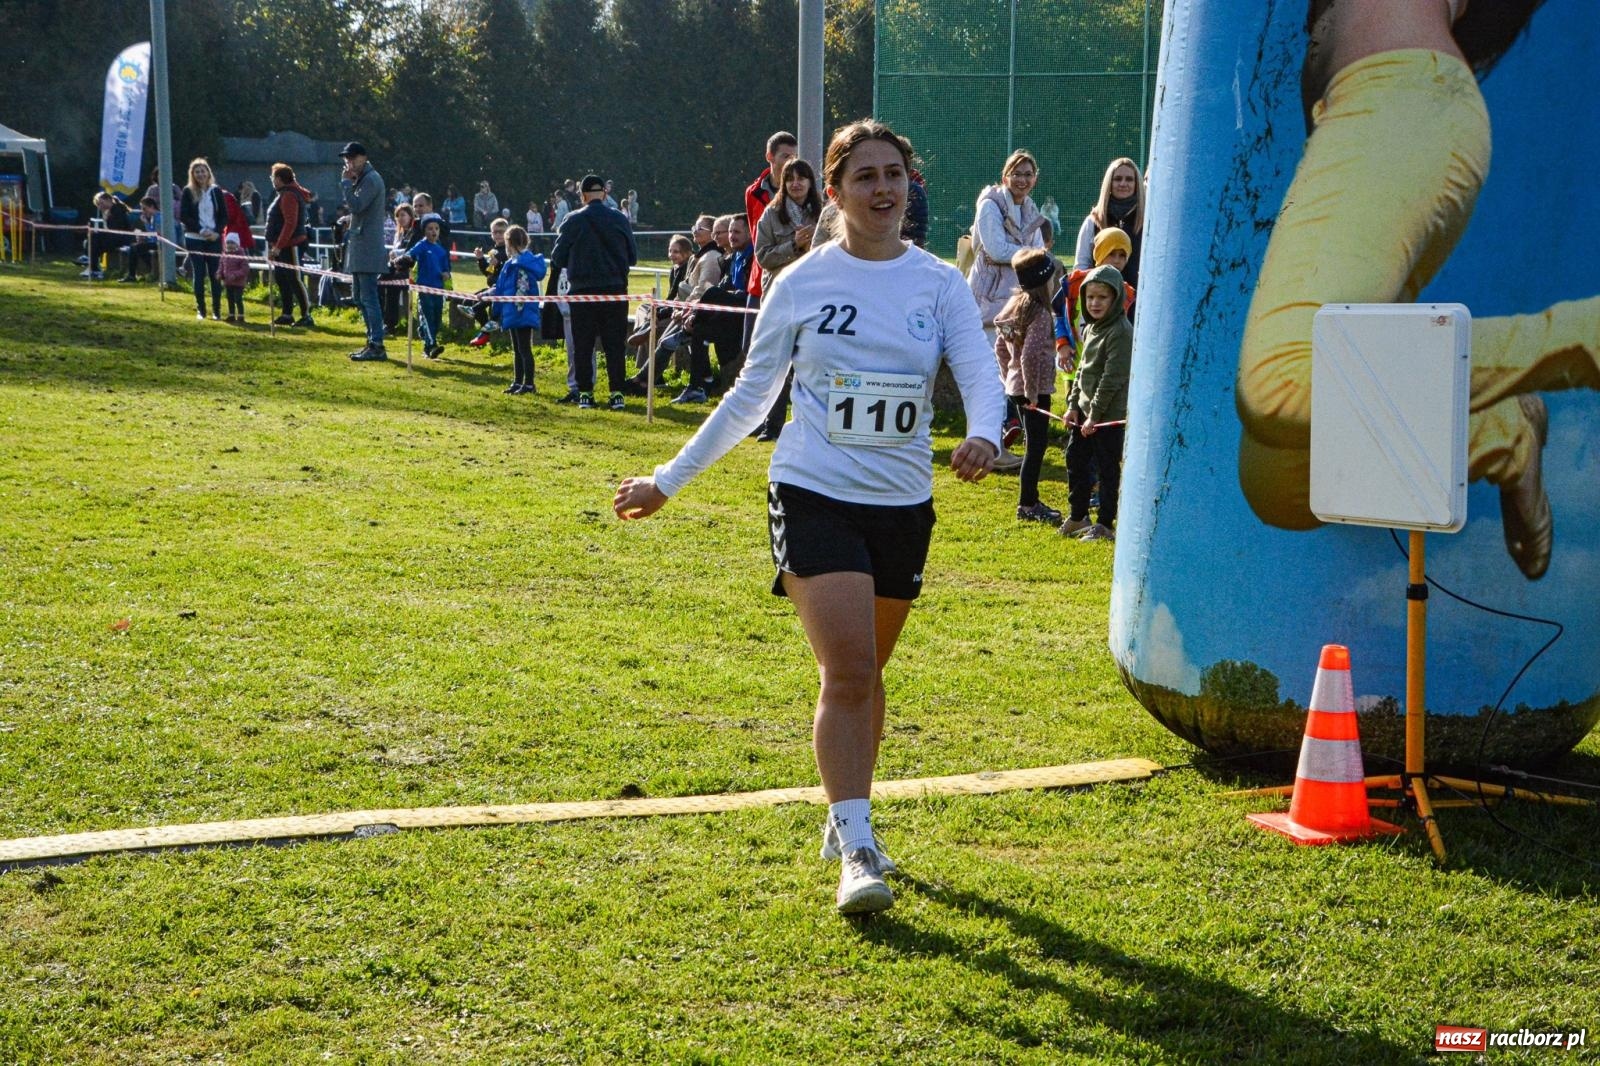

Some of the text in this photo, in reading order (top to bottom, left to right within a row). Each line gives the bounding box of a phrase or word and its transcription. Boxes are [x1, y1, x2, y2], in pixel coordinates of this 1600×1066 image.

[817, 304, 858, 336] 22
[866, 380, 923, 390] www.personalbest.pl
[835, 397, 917, 433] 110
